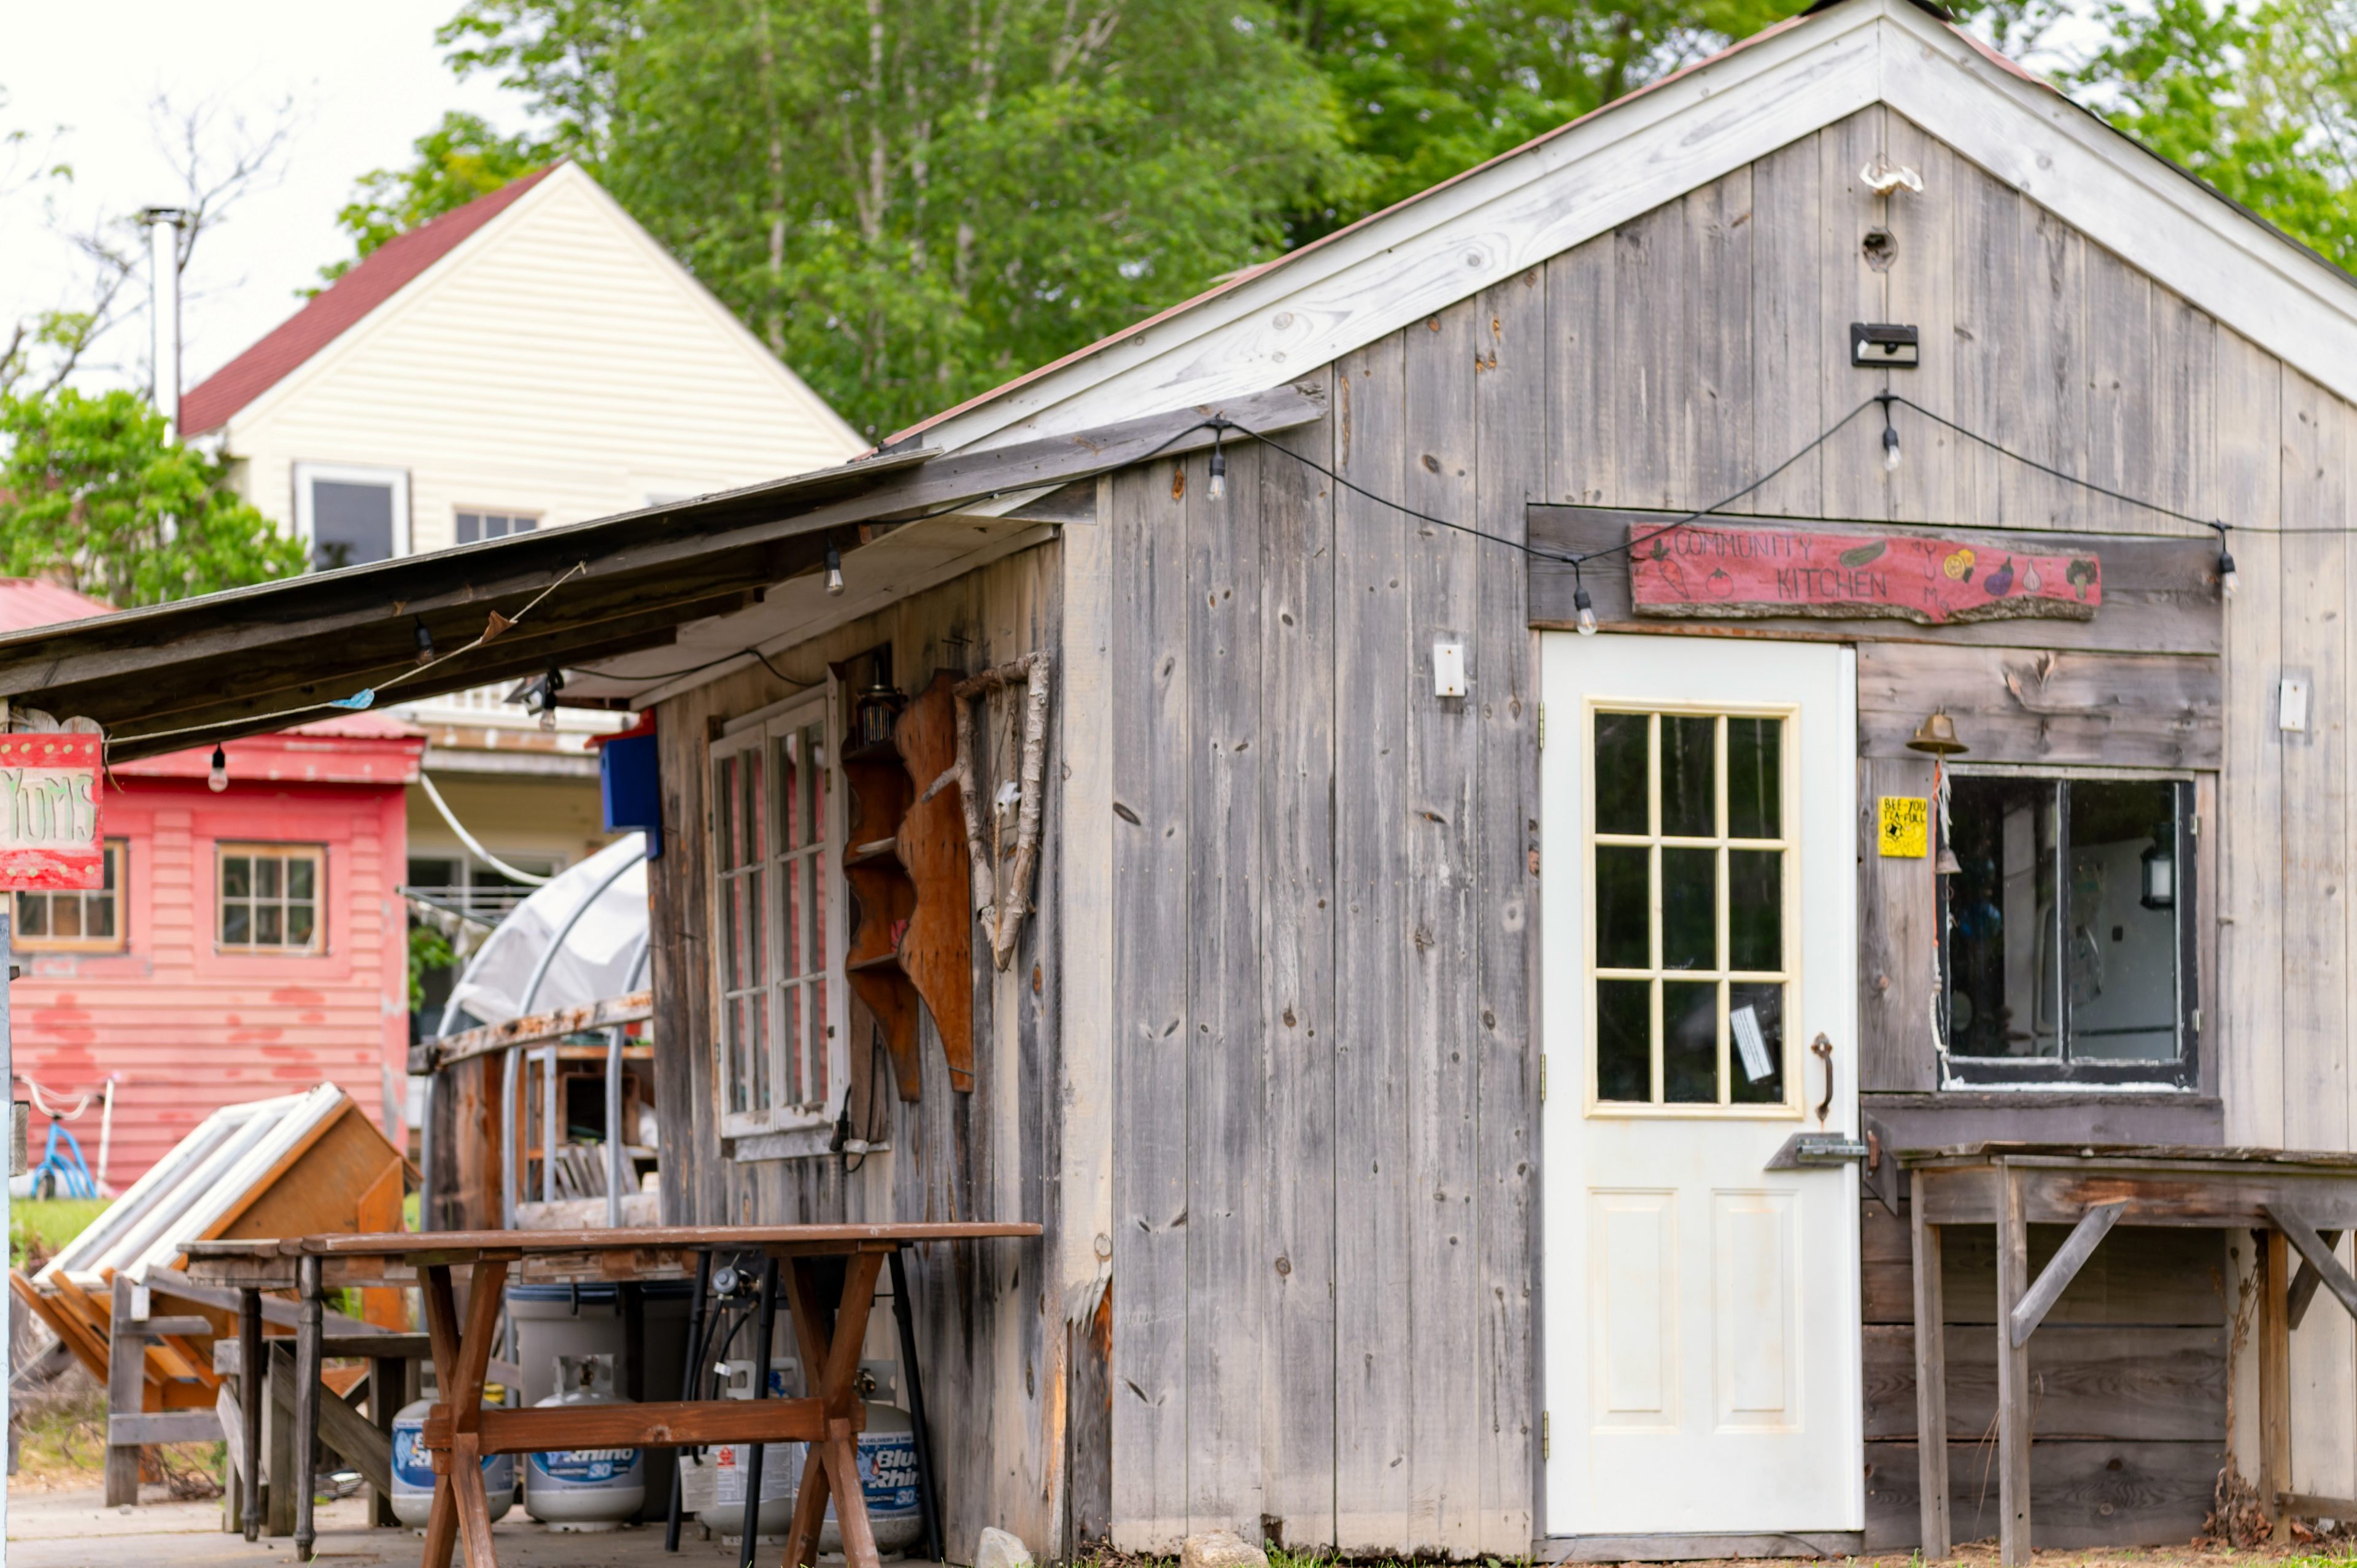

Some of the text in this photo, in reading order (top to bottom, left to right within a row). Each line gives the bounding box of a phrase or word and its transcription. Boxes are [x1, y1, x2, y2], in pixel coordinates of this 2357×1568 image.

[1675, 530, 1811, 560] COMMUNITY
[1778, 567, 1887, 599] KITCHEN
[1, 768, 96, 843] YUMS
[868, 1467, 920, 1488] Rhin
